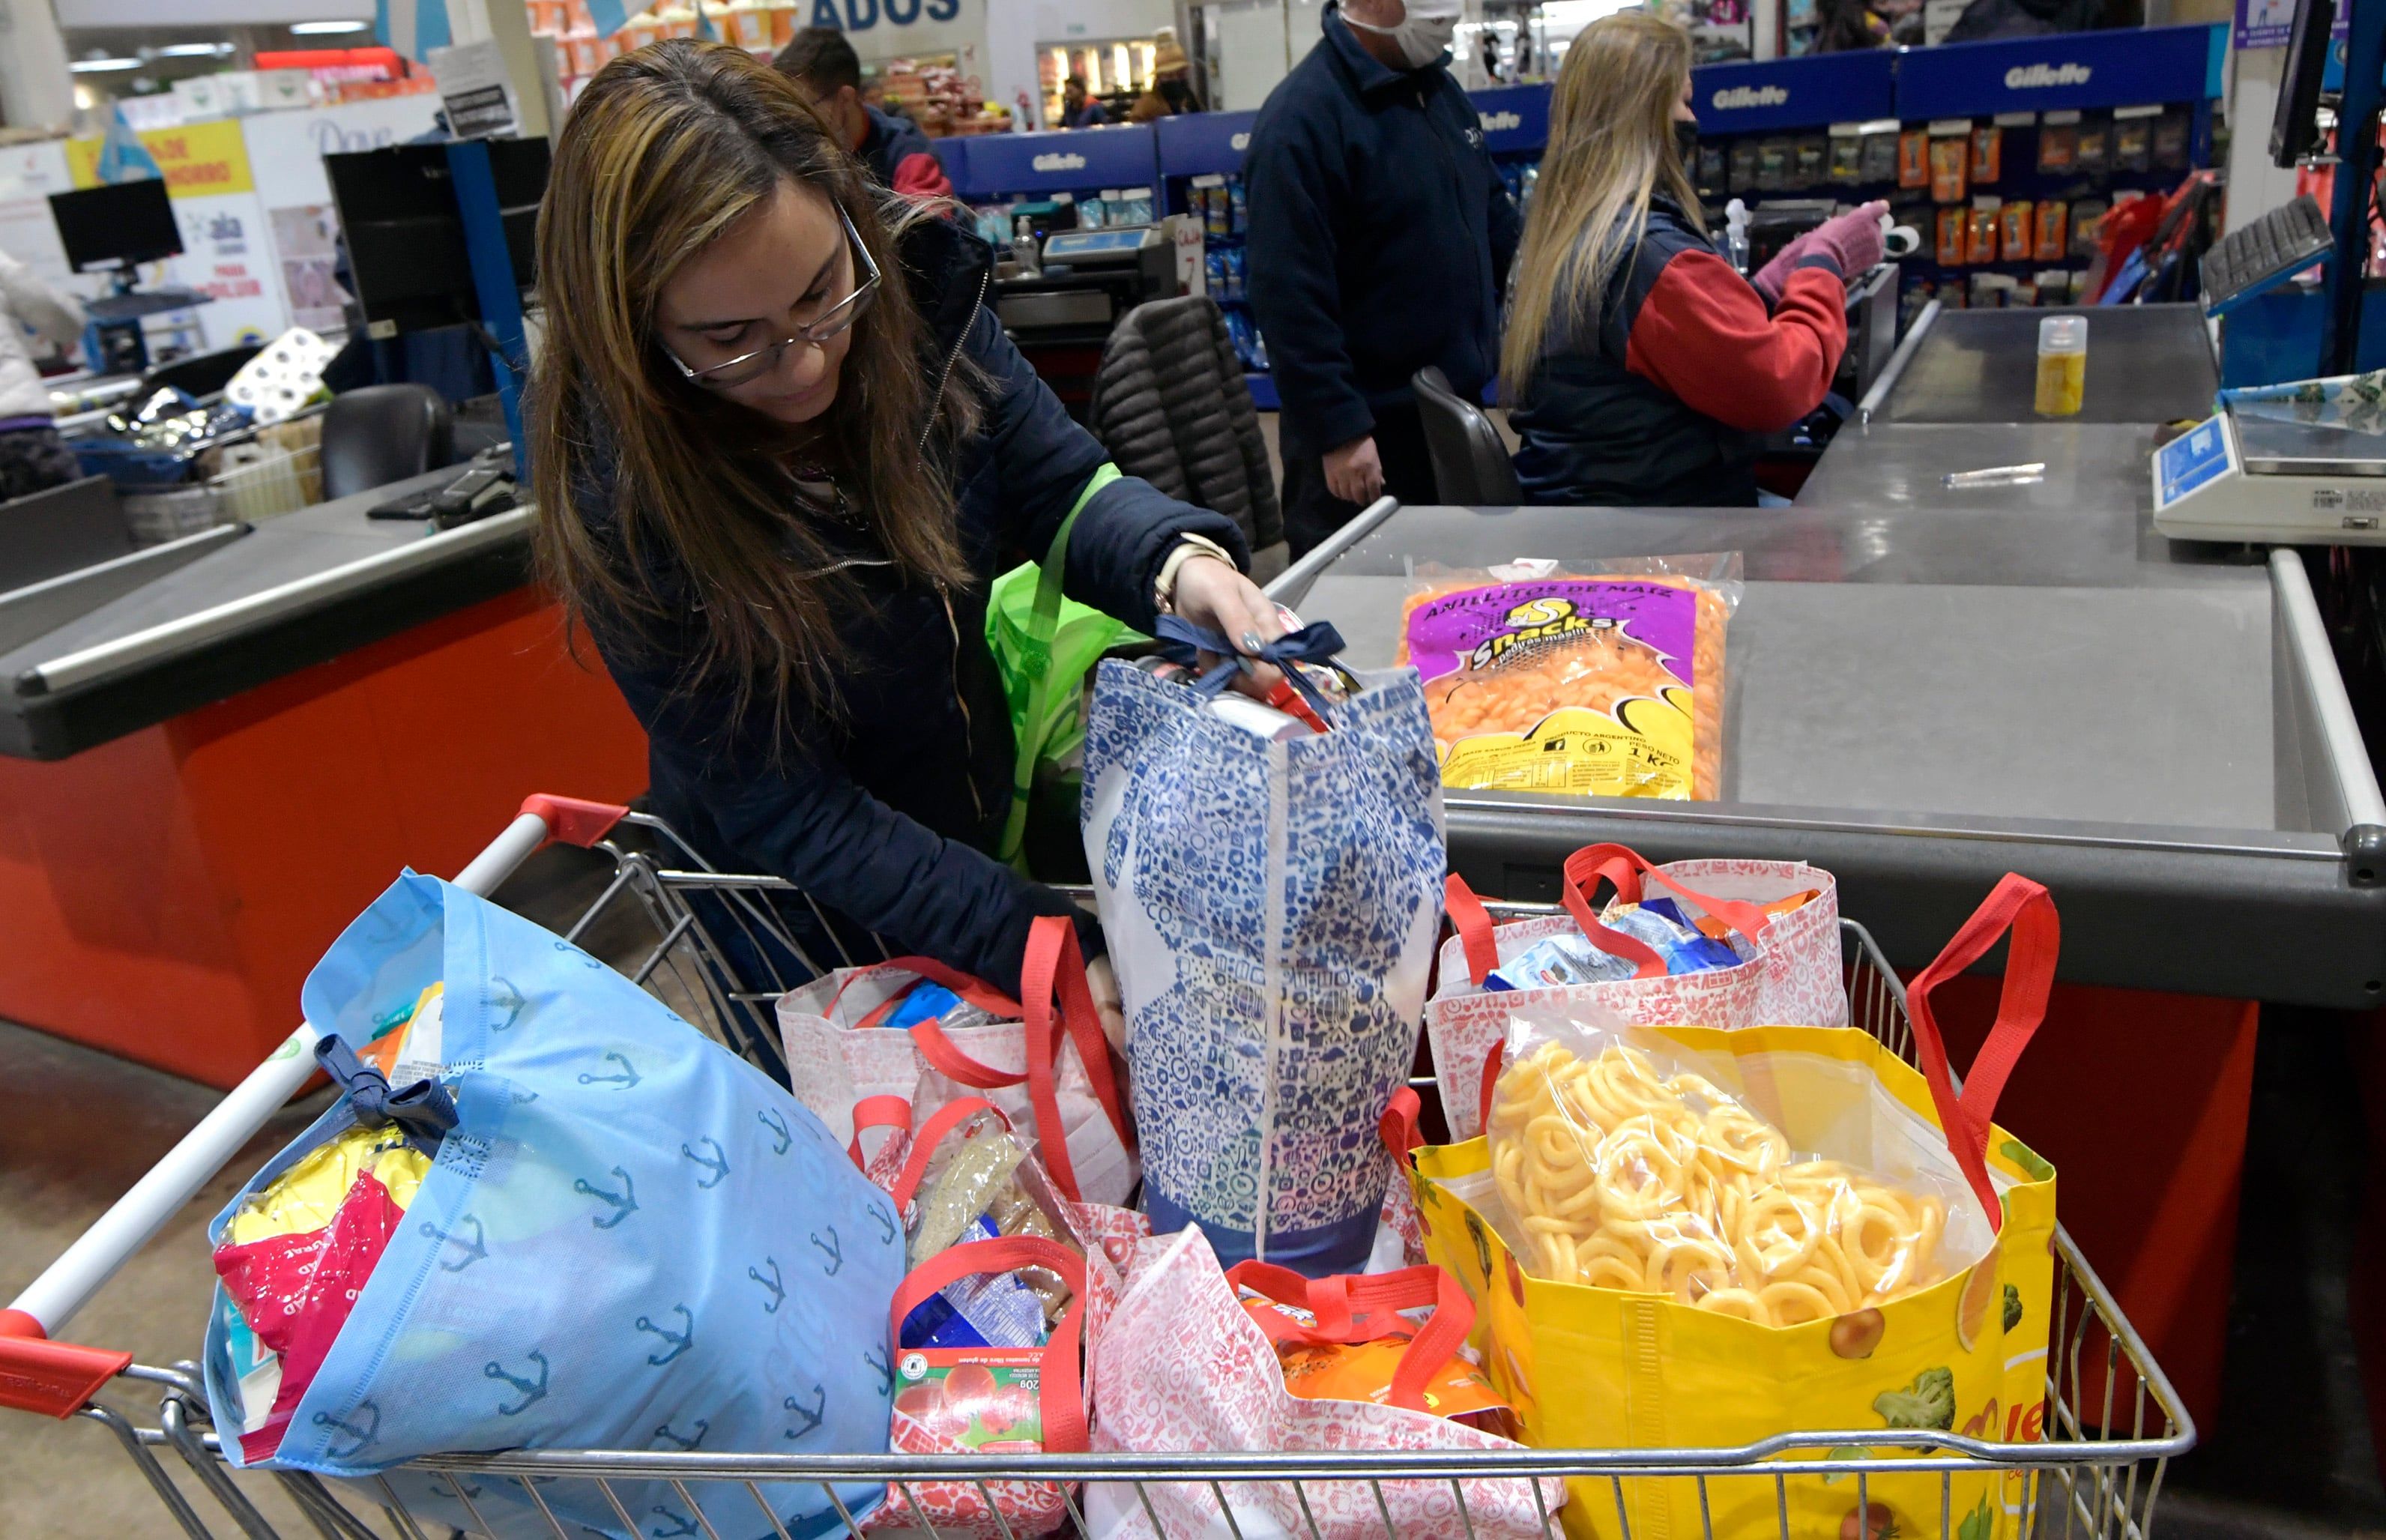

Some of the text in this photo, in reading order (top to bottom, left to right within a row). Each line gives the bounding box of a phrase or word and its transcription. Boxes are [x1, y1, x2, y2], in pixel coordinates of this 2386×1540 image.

[2004, 63, 2092, 89] Gillette
[1712, 85, 1788, 110] Gillette
[1478, 111, 1520, 131] lette
[1032, 152, 1087, 172] Gillette
[1424, 585, 1559, 621] ANILLITOS
[1567, 585, 1600, 593] DE
[1473, 616, 1613, 671] Snacks
[1544, 731, 1647, 743] PRODUCTO ARGENTINO
[1628, 747, 1642, 758] 1
[1629, 740, 1680, 765] PESO NETO
